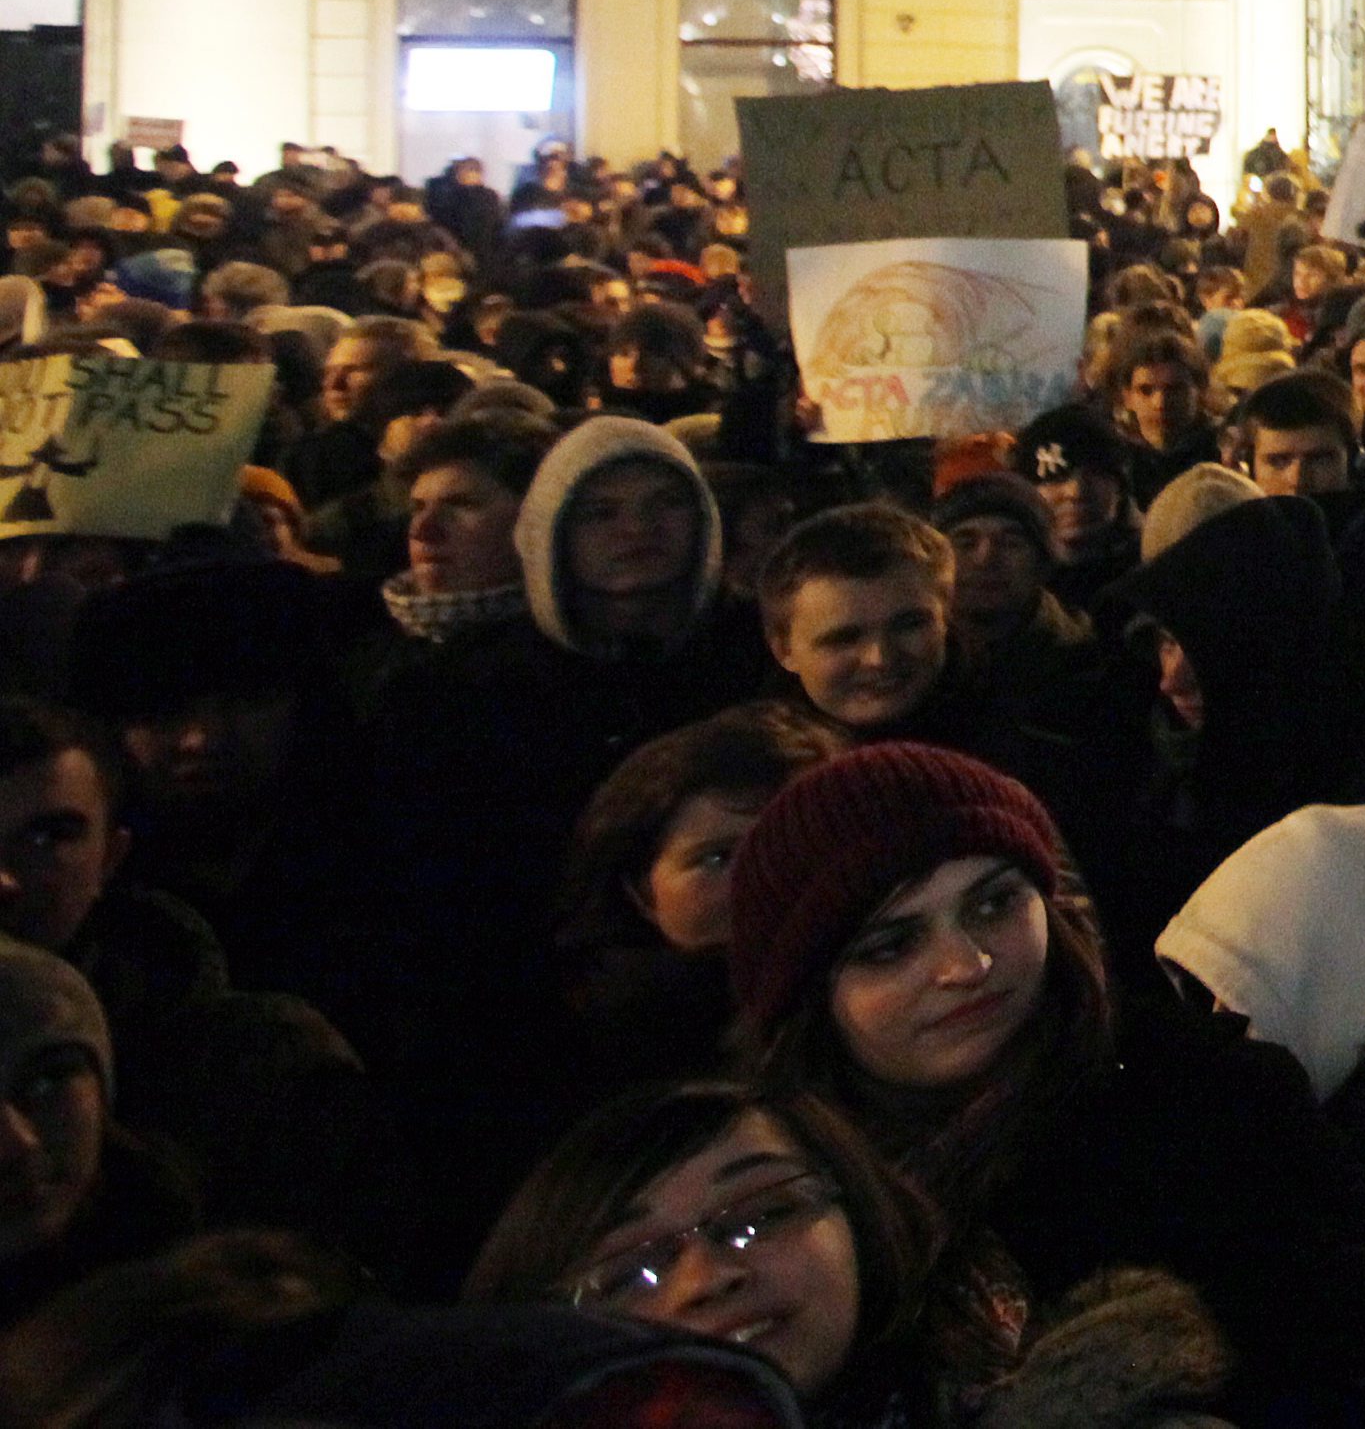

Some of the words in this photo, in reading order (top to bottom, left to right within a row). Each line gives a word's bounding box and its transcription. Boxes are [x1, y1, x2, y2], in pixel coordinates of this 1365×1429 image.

[1098, 71, 1165, 111] WE
[1169, 73, 1220, 111] ARE
[833, 136, 1012, 201] ACTA
[64, 358, 230, 400] SHALL
[77, 391, 221, 435] PASS
